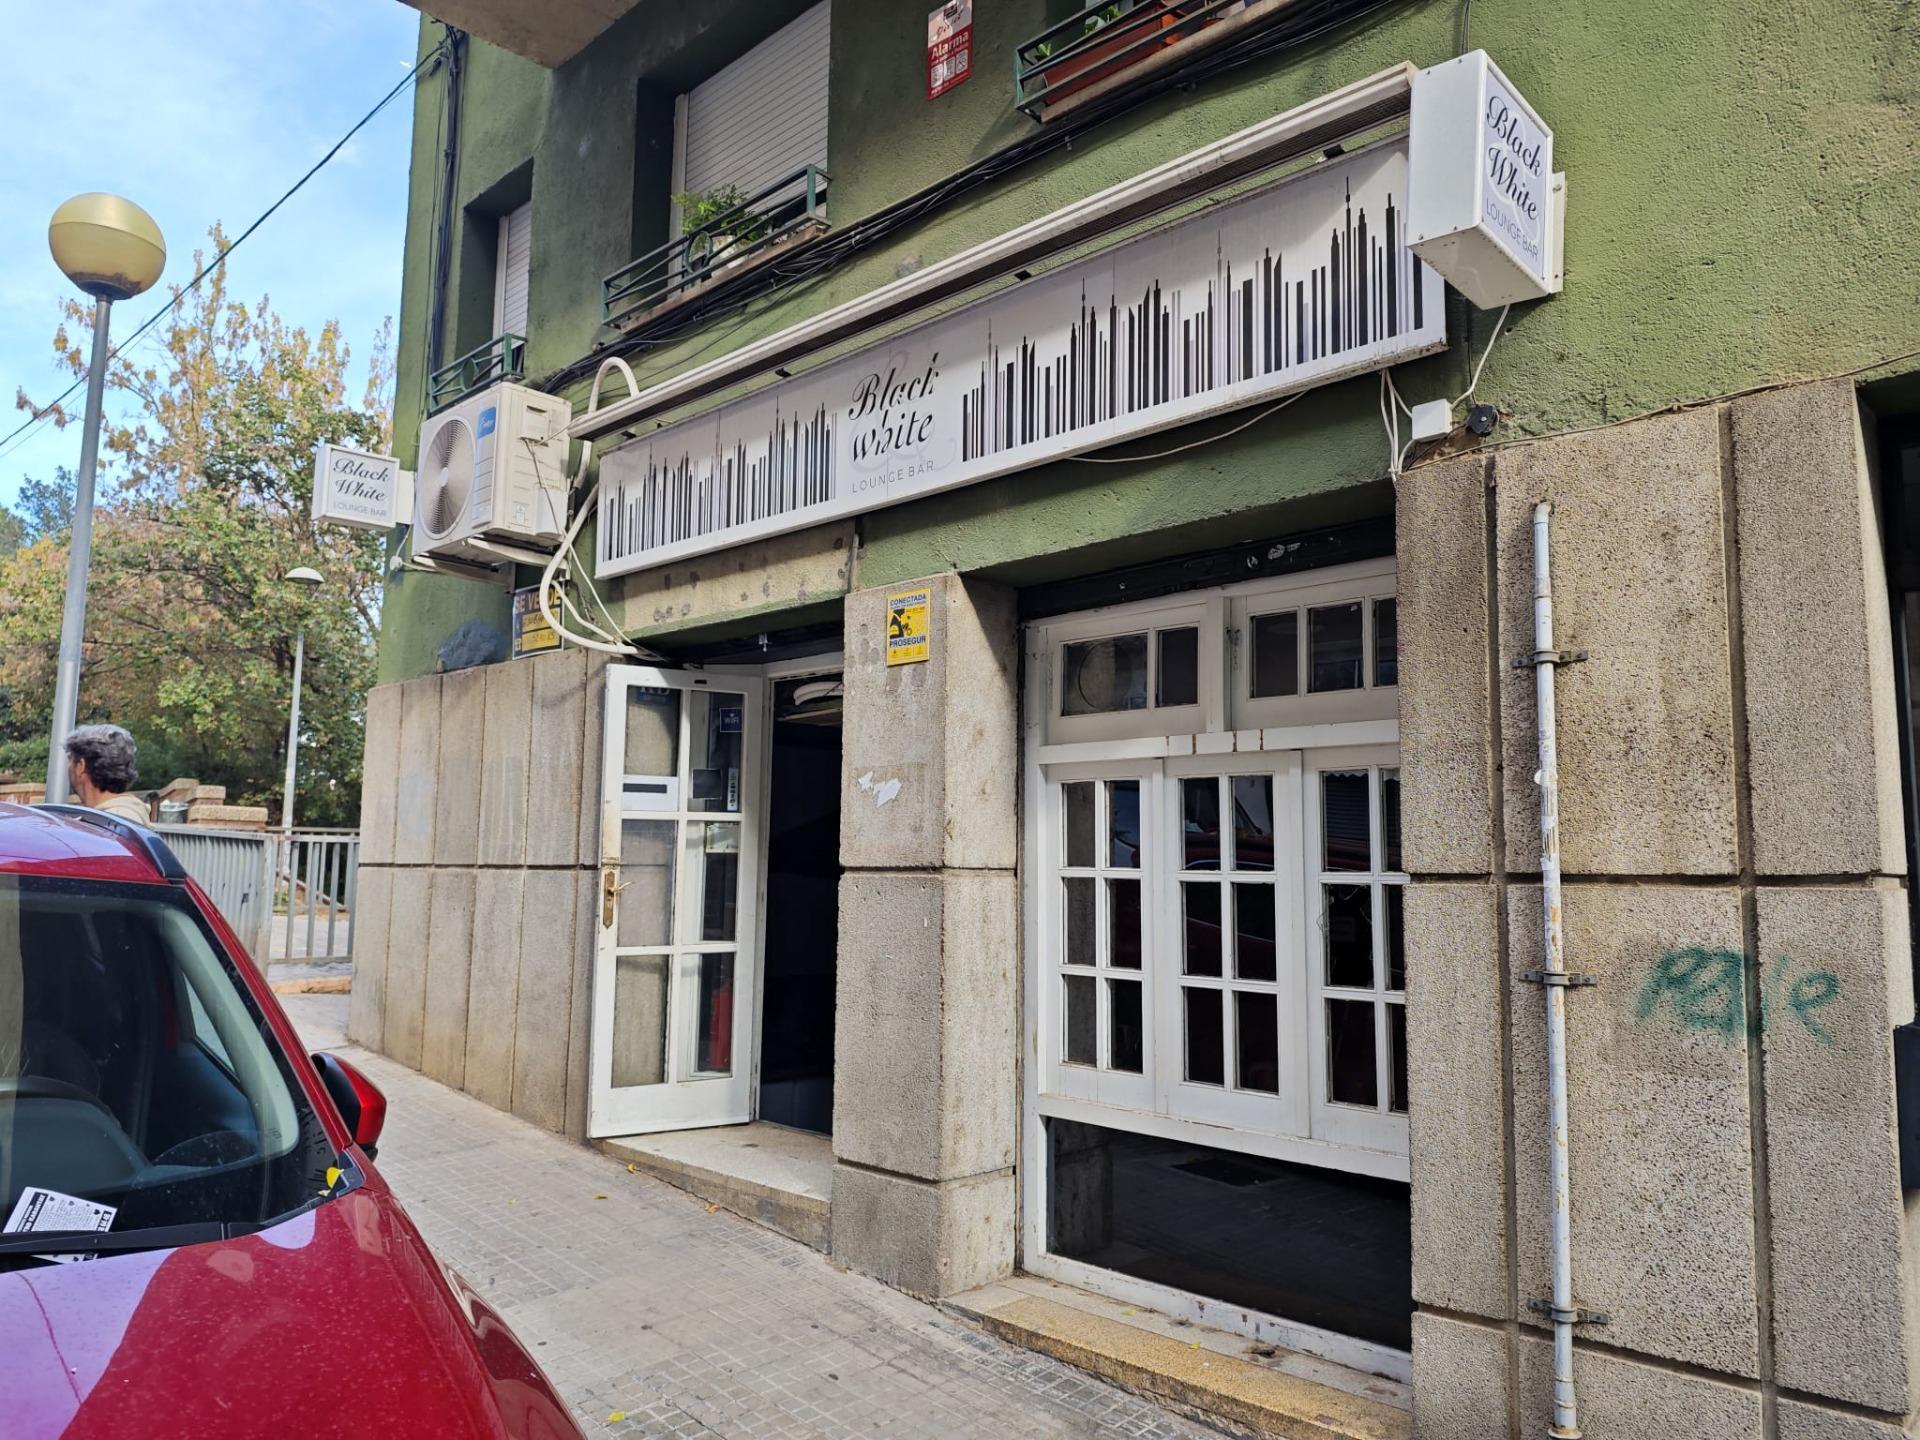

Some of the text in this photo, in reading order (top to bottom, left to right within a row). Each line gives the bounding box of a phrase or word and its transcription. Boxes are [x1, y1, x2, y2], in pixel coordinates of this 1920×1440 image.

[1486, 95, 1543, 178] Black
[1488, 147, 1539, 221] White
[1486, 198, 1539, 262] LOUNGE BAR
[853, 409, 933, 463] White
[333, 458, 389, 482] Black
[335, 479, 387, 501] White
[852, 459, 935, 493] LOUNGE BAR
[333, 502, 368, 514] LOUNGE
